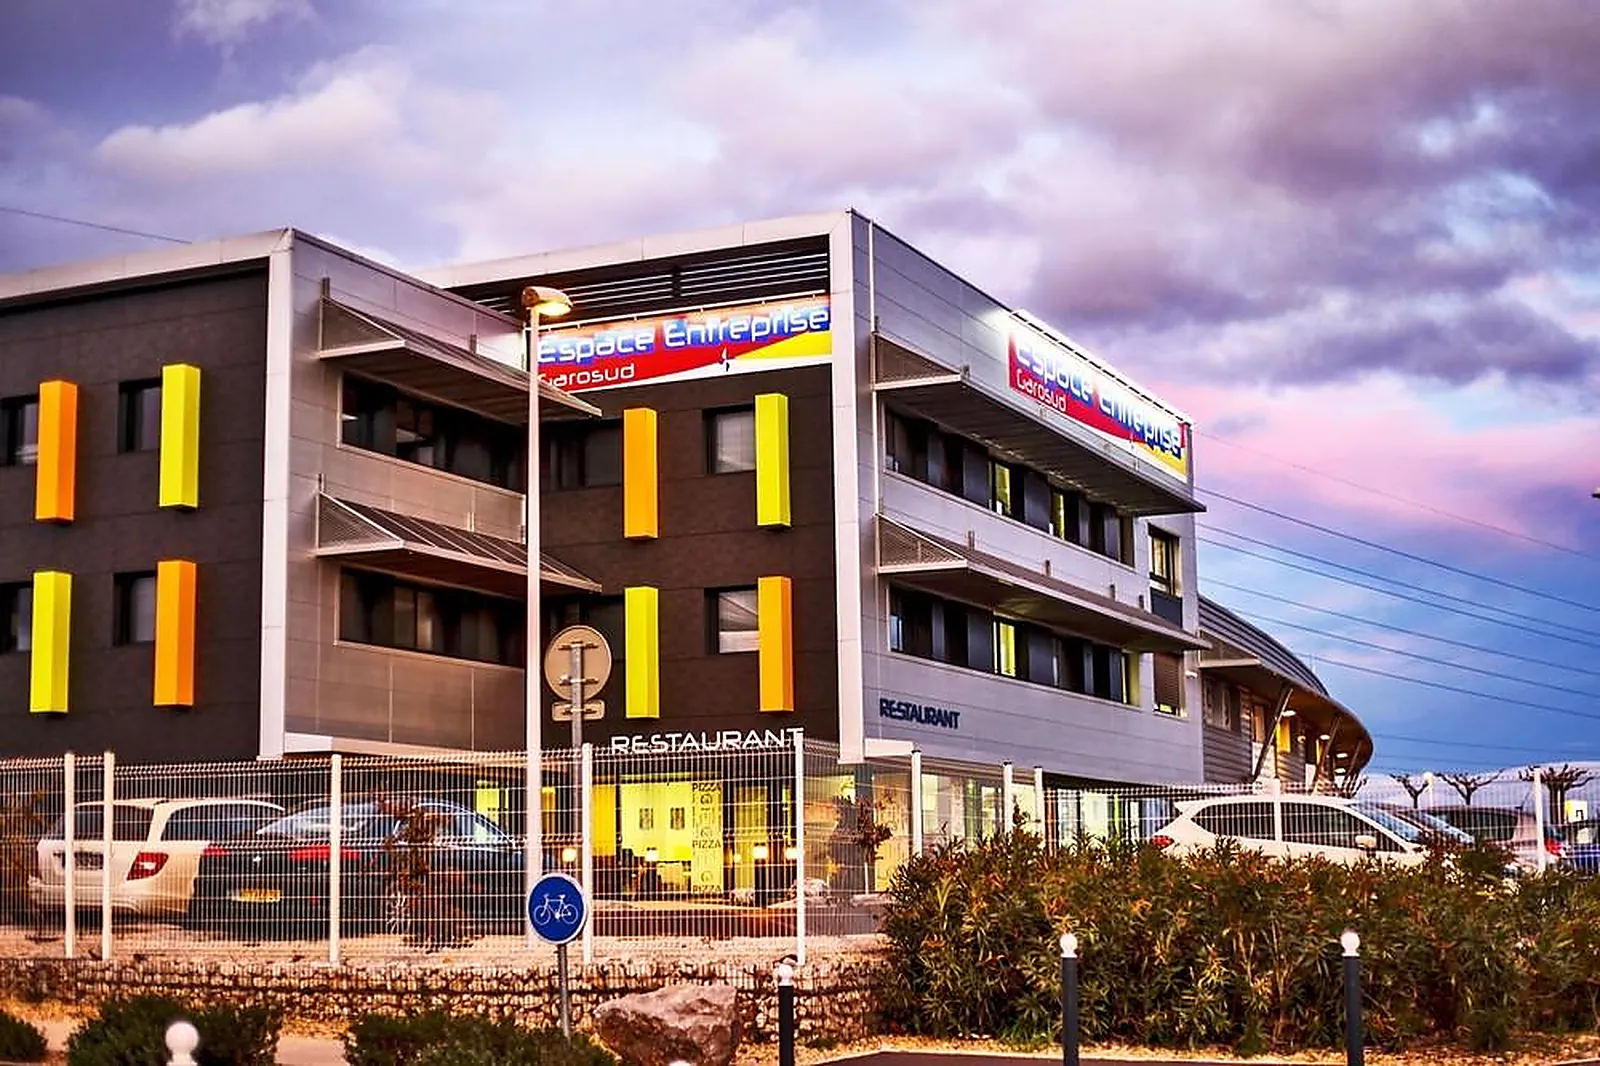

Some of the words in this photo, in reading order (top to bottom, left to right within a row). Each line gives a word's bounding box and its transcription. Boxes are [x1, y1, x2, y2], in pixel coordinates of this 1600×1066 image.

[538, 331, 655, 363] Espace
[663, 305, 830, 347] Entreprise
[880, 697, 961, 730] RESTAURANT
[611, 727, 804, 755] RESTAURANT
[692, 840, 722, 849] PIZZA
